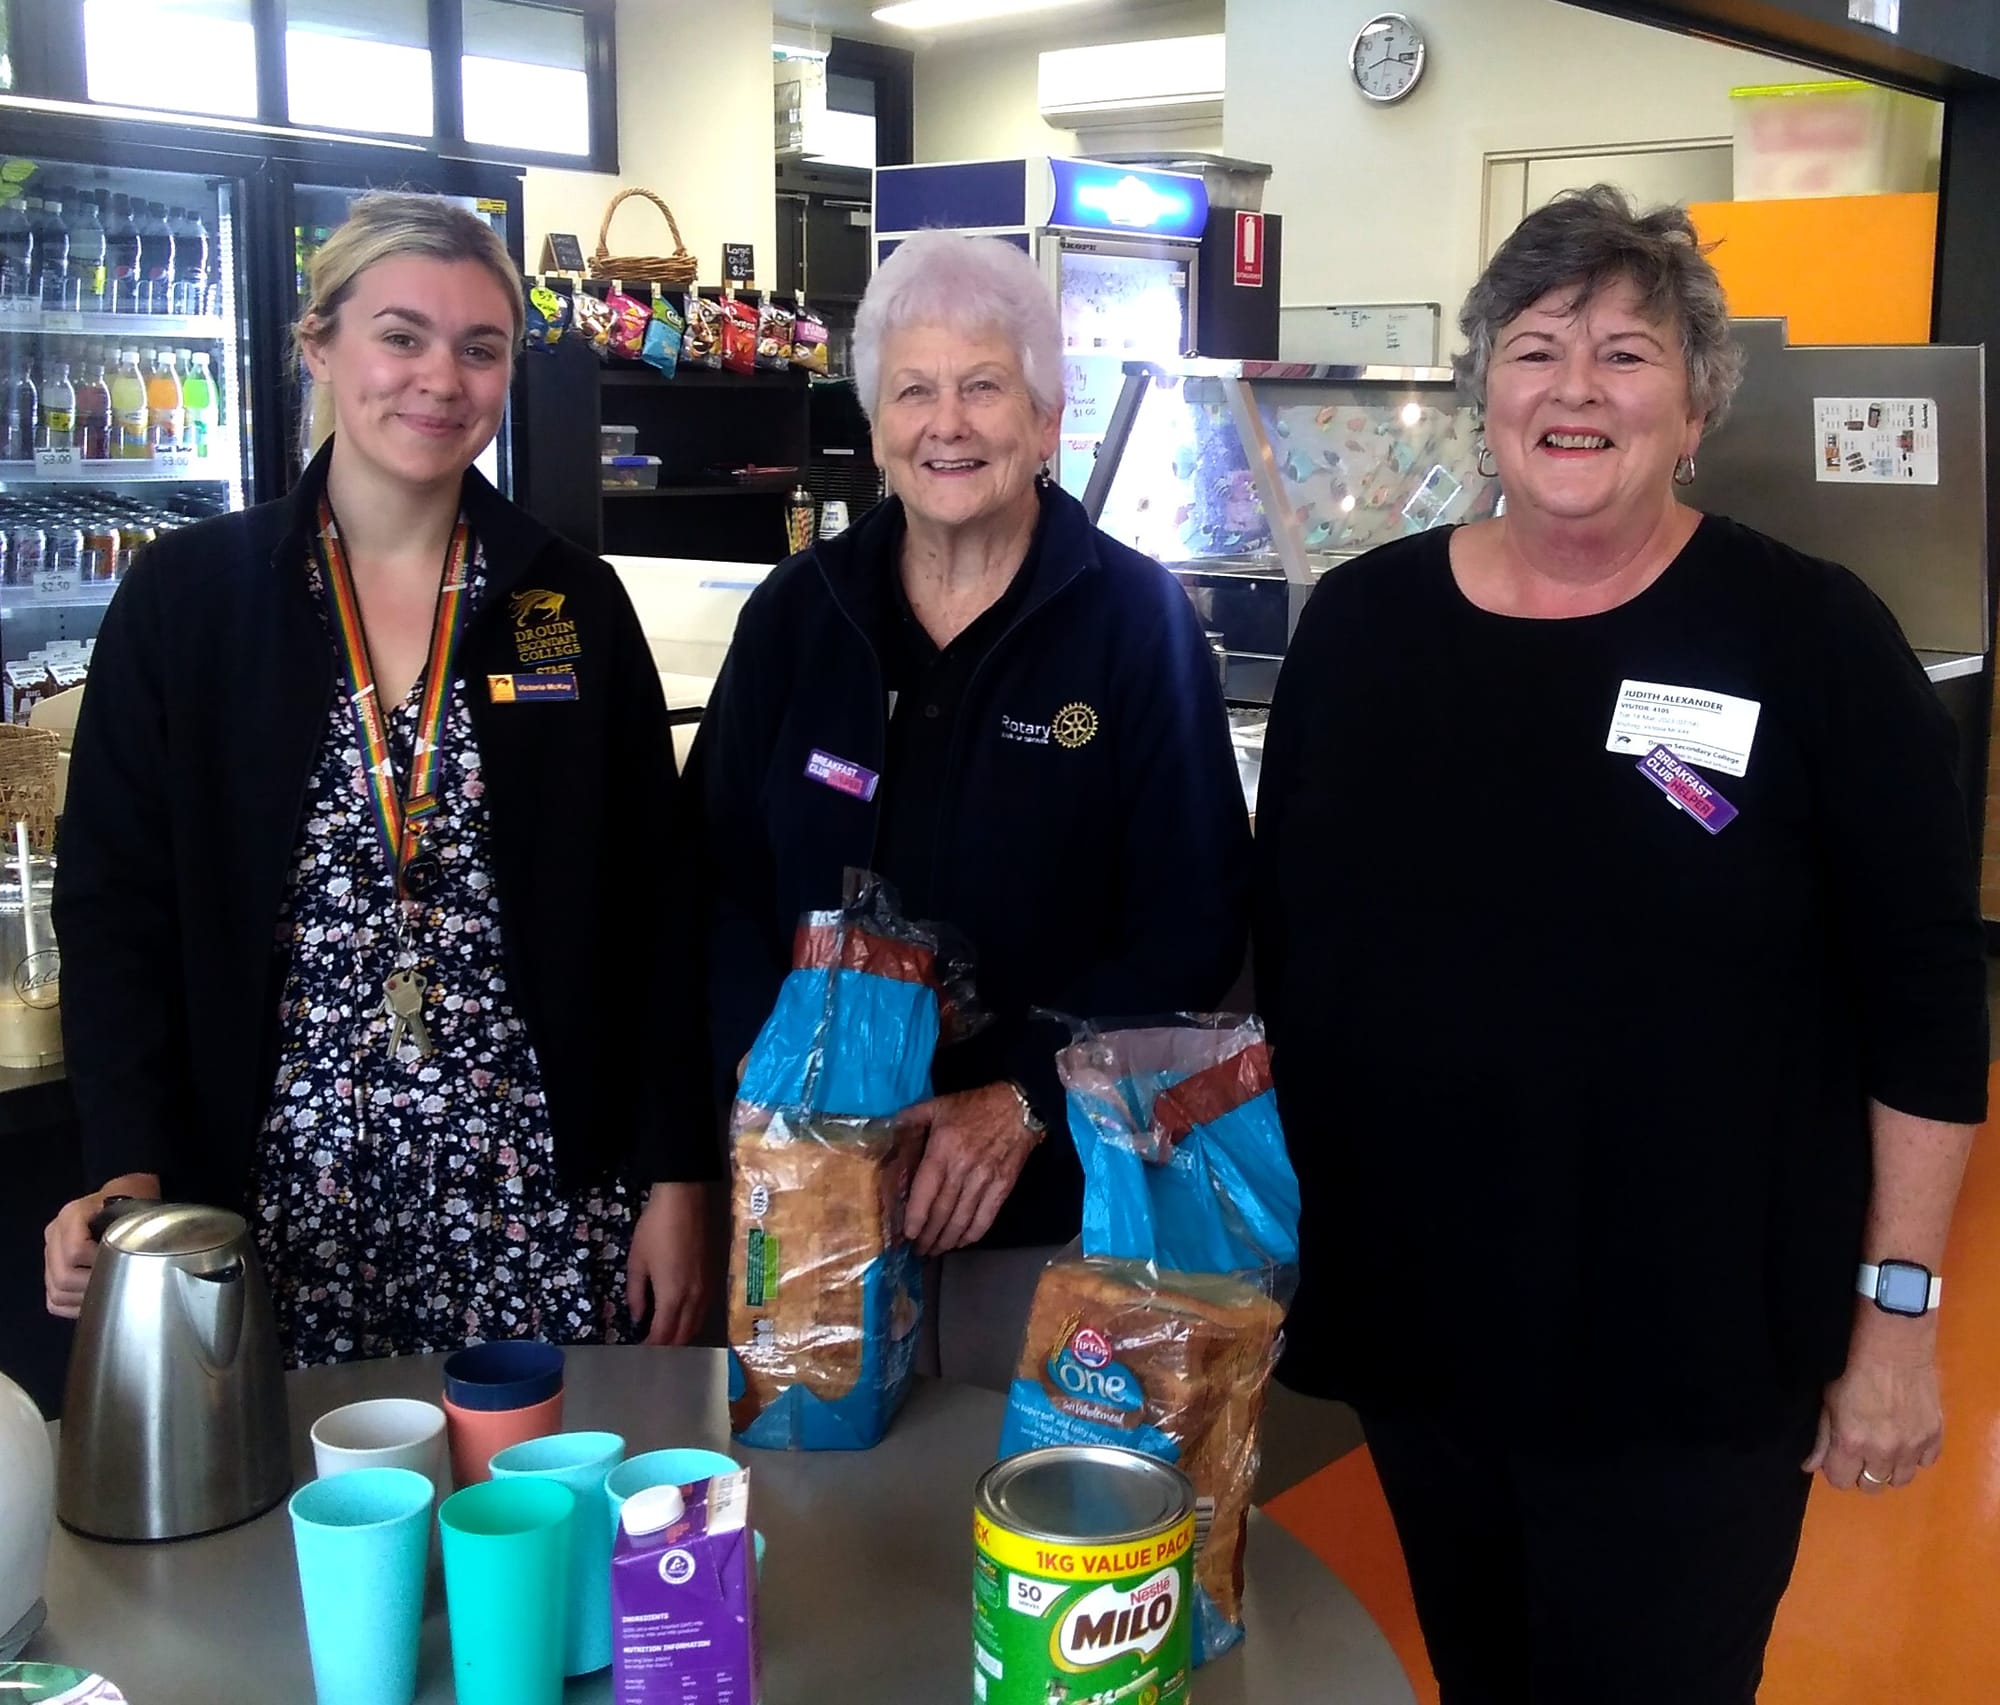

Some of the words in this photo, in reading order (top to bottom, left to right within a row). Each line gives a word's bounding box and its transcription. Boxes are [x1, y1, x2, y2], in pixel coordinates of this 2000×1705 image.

[514, 620, 575, 642] DROUIN
[517, 633, 578, 653] SECONDARY
[520, 643, 582, 662] COLLEGE
[1624, 690, 1660, 700] JUDITH
[1662, 695, 1723, 711] ALEXANDER
[1002, 715, 1051, 739] Rotary
[812, 753, 858, 777] BREAKFAST
[1674, 743, 1711, 757] Secondary
[1713, 752, 1739, 764] College
[1654, 749, 1712, 798] BREAKFAST
[1646, 758, 1674, 783] CLUB
[1670, 780, 1711, 816] HELPER
[1060, 1363, 1127, 1402] One
[1075, 1403, 1125, 1424] Wholemeal
[975, 1519, 989, 1546] CK
[1036, 1550, 1074, 1573] 1KG
[1081, 1548, 1152, 1574] VALUE
[1157, 1528, 1190, 1561] PACK
[1018, 1581, 1042, 1602] 50
[1129, 1575, 1170, 1605] Nestlé
[622, 1612, 669, 1623] INGREDIENTS
[1071, 1593, 1172, 1651] MILO
[623, 1644, 662, 1654] NUTRITION
[663, 1640, 711, 1652] INFORMATION
